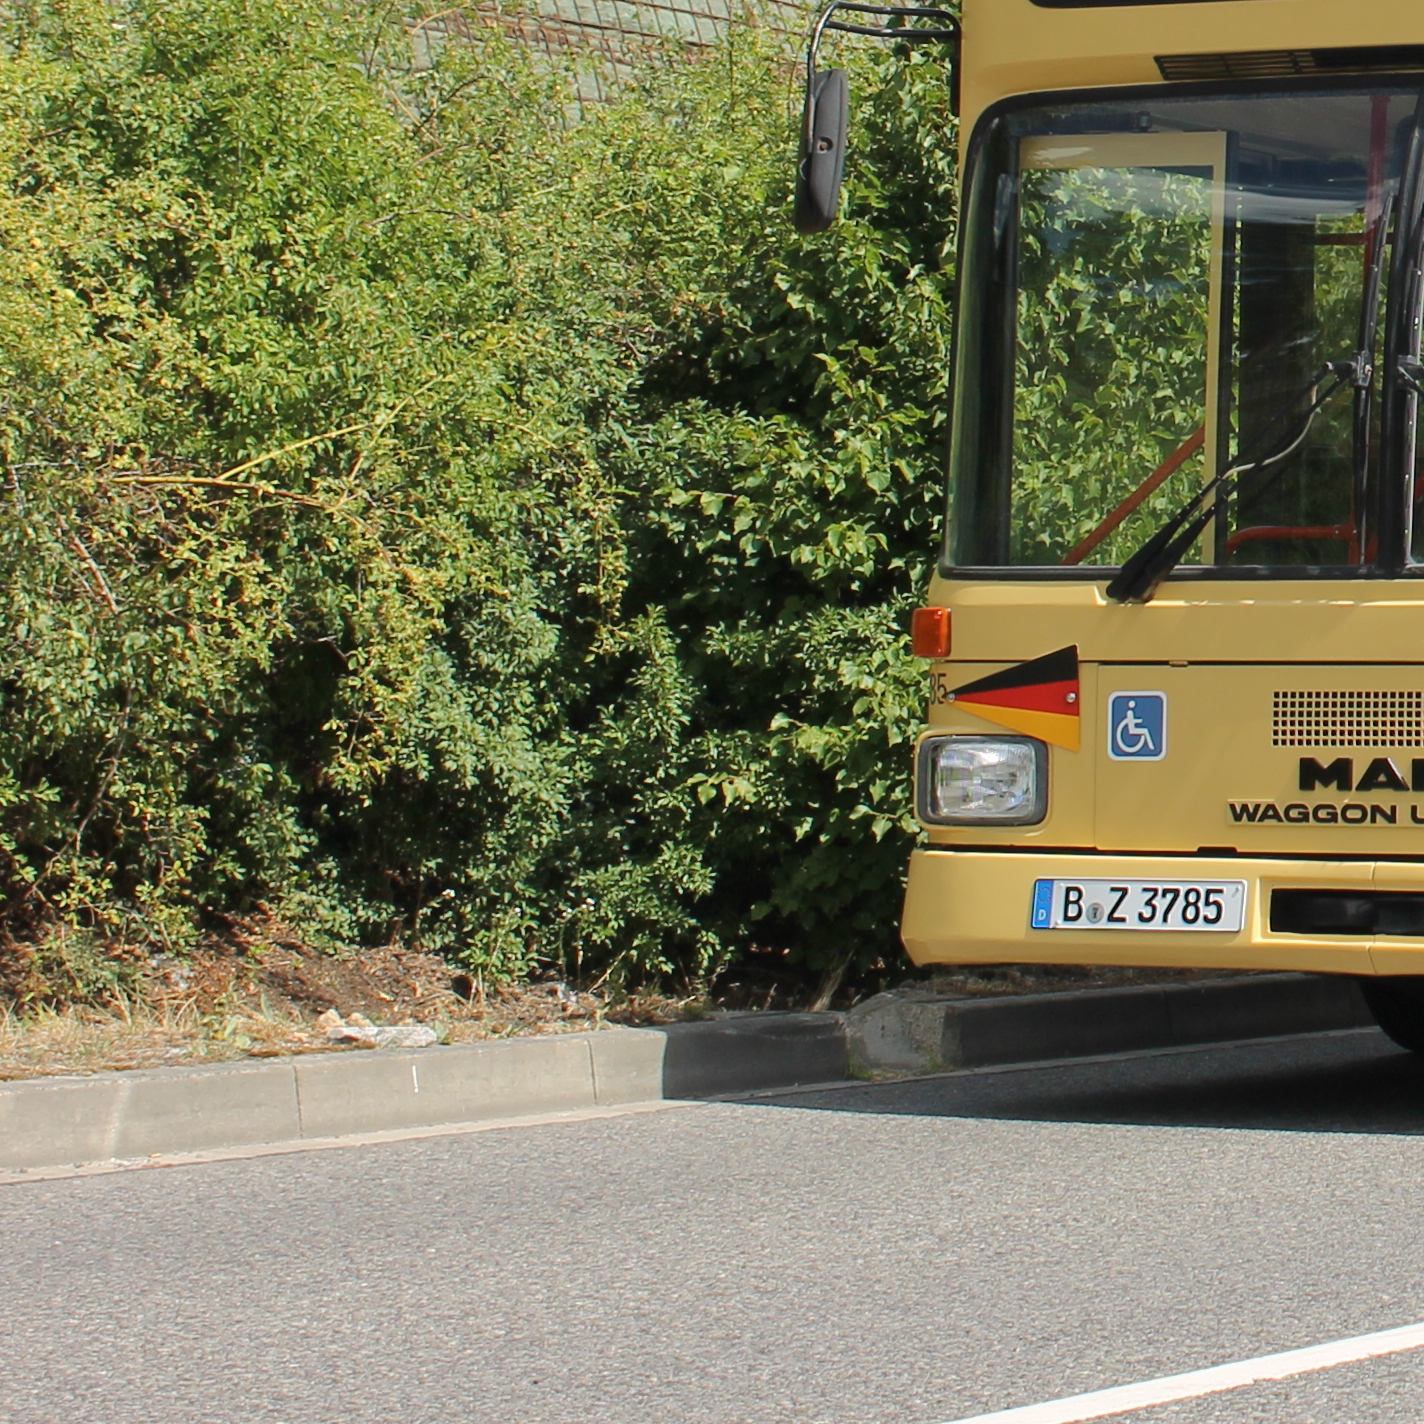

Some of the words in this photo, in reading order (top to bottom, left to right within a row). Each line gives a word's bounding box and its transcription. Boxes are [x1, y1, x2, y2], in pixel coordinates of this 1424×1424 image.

[1228, 802, 1398, 824] WAGGON
[1037, 909, 1046, 921] D
[1062, 886, 1084, 922] B
[1106, 886, 1129, 923] Z
[1137, 887, 1224, 924] 3785
